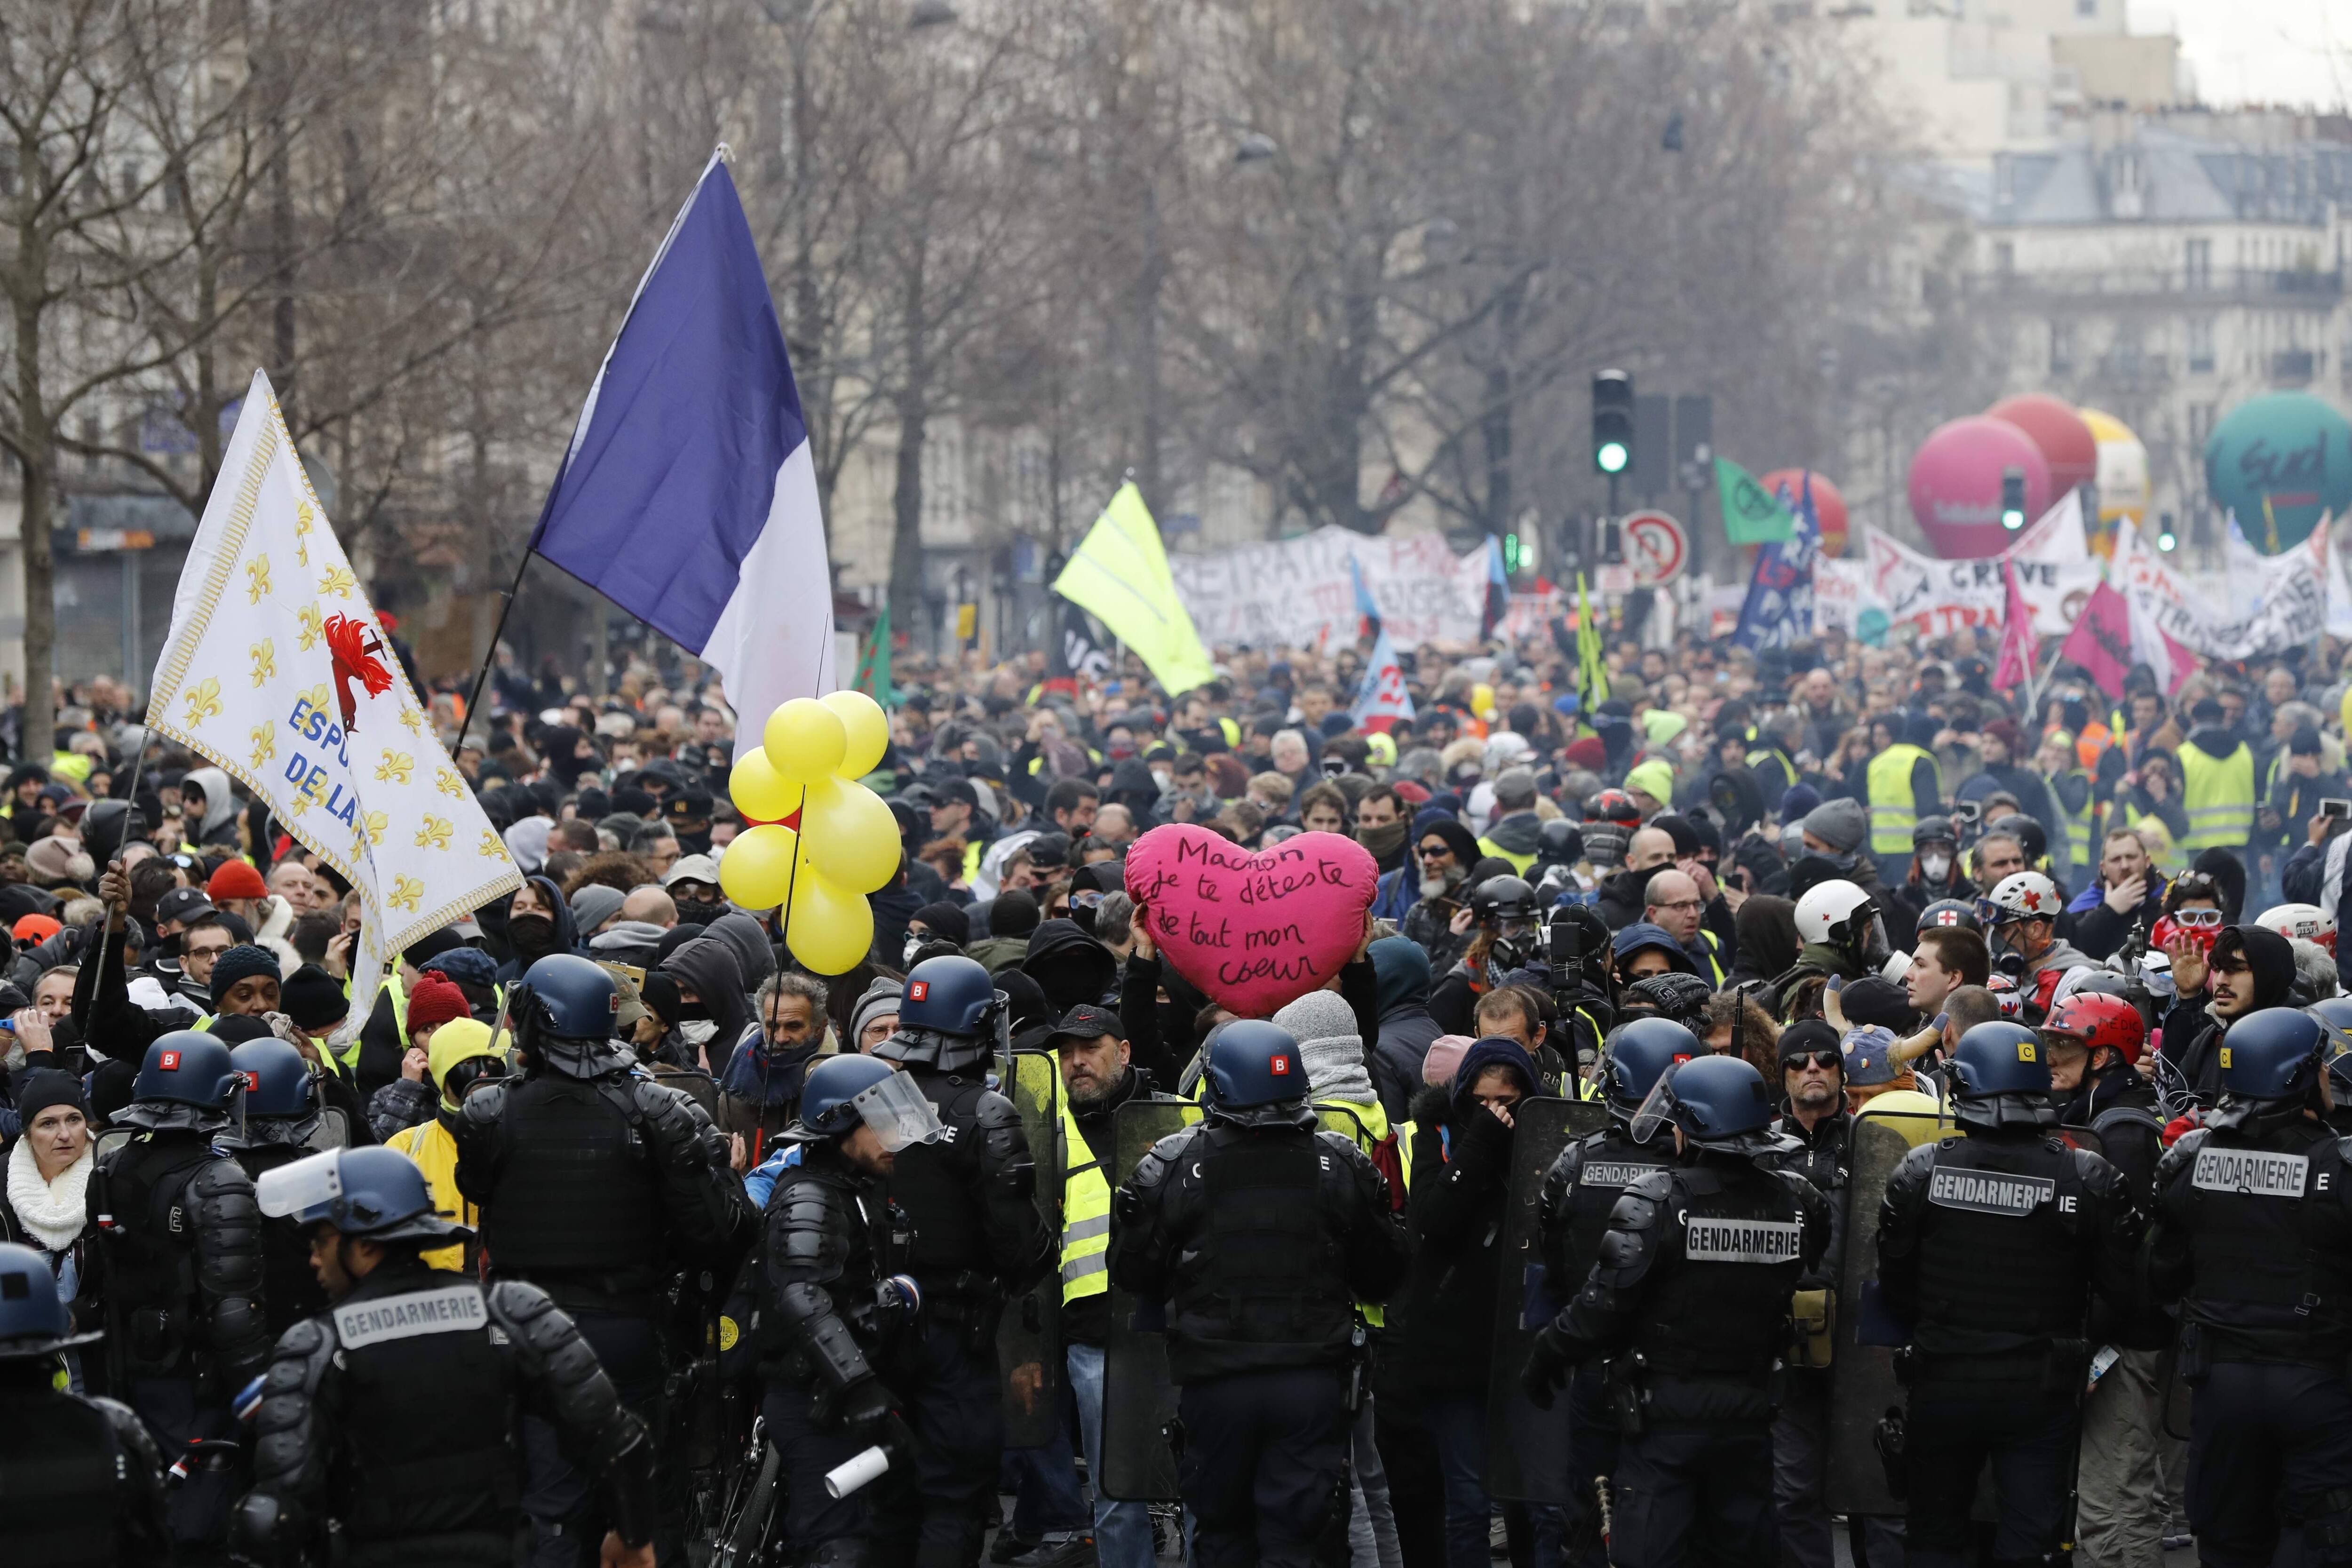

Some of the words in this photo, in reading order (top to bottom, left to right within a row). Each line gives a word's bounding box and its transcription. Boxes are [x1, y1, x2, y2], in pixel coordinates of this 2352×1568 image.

[285, 752, 327, 797] DE
[325, 783, 356, 828] LA
[1178, 837, 1303, 871] Macron
[1150, 860, 1180, 899] je
[1197, 873, 1222, 901] te
[1240, 858, 1353, 905] déteste
[1159, 906, 1180, 935] de
[1189, 911, 1231, 947] tout
[1246, 923, 1304, 950] mon
[914, 986, 922, 997] B
[164, 1055, 174, 1066] B
[1276, 1060, 1284, 1071] B
[2024, 1047, 2032, 1058] C
[2220, 1053, 2227, 1064] C
[2197, 1154, 2304, 1191] GENDARMERIE
[1688, 1226, 1800, 1257] GENDARMERIE
[343, 1296, 481, 1338] GENDARMERIE
